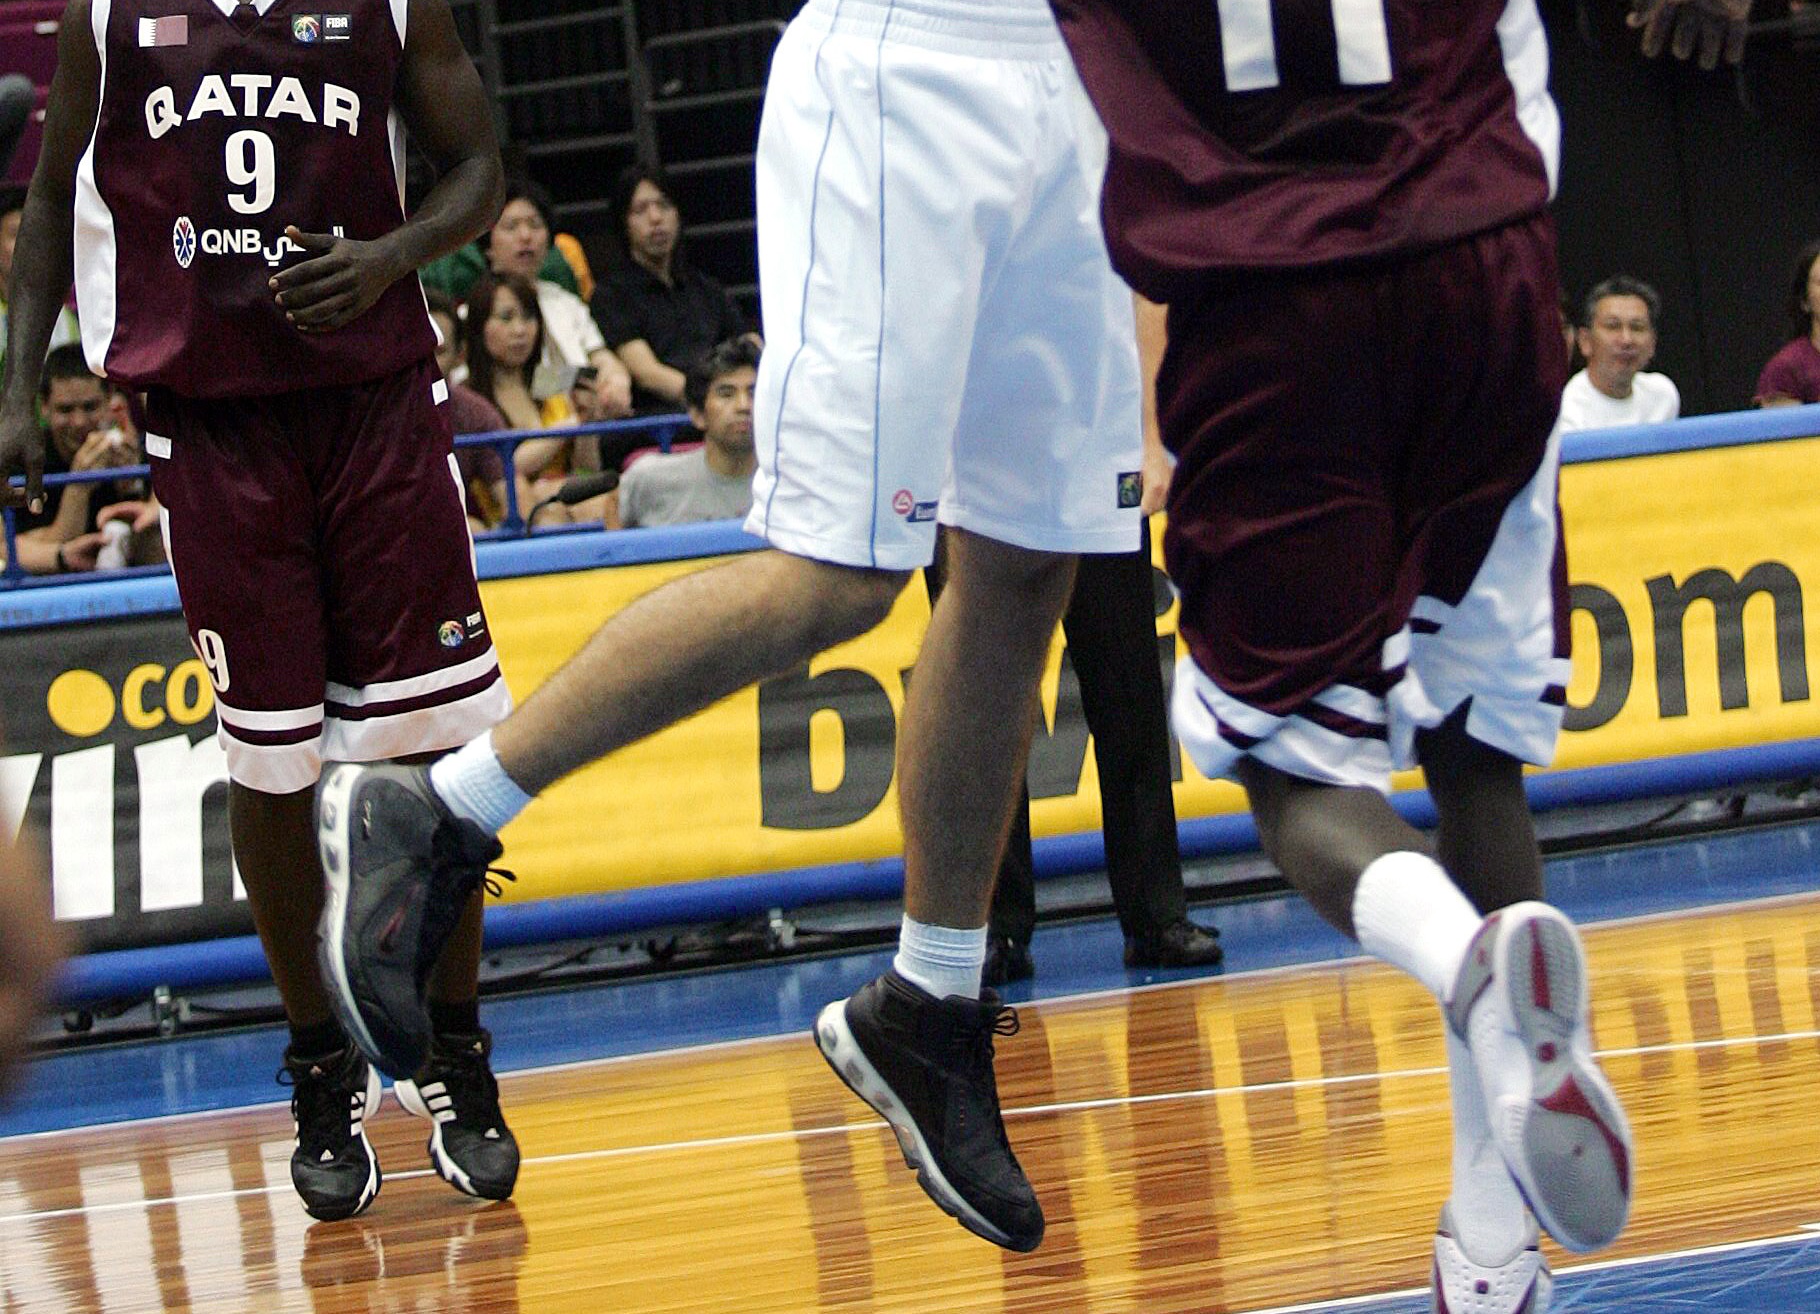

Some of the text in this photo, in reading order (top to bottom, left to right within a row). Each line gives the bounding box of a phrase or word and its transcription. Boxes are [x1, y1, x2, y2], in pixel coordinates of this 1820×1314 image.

[325, 17, 348, 28] FIBA
[145, 73, 361, 140] QATAR
[225, 129, 276, 215] 9
[201, 228, 262, 255] QNB
[198, 629, 230, 693] 9
